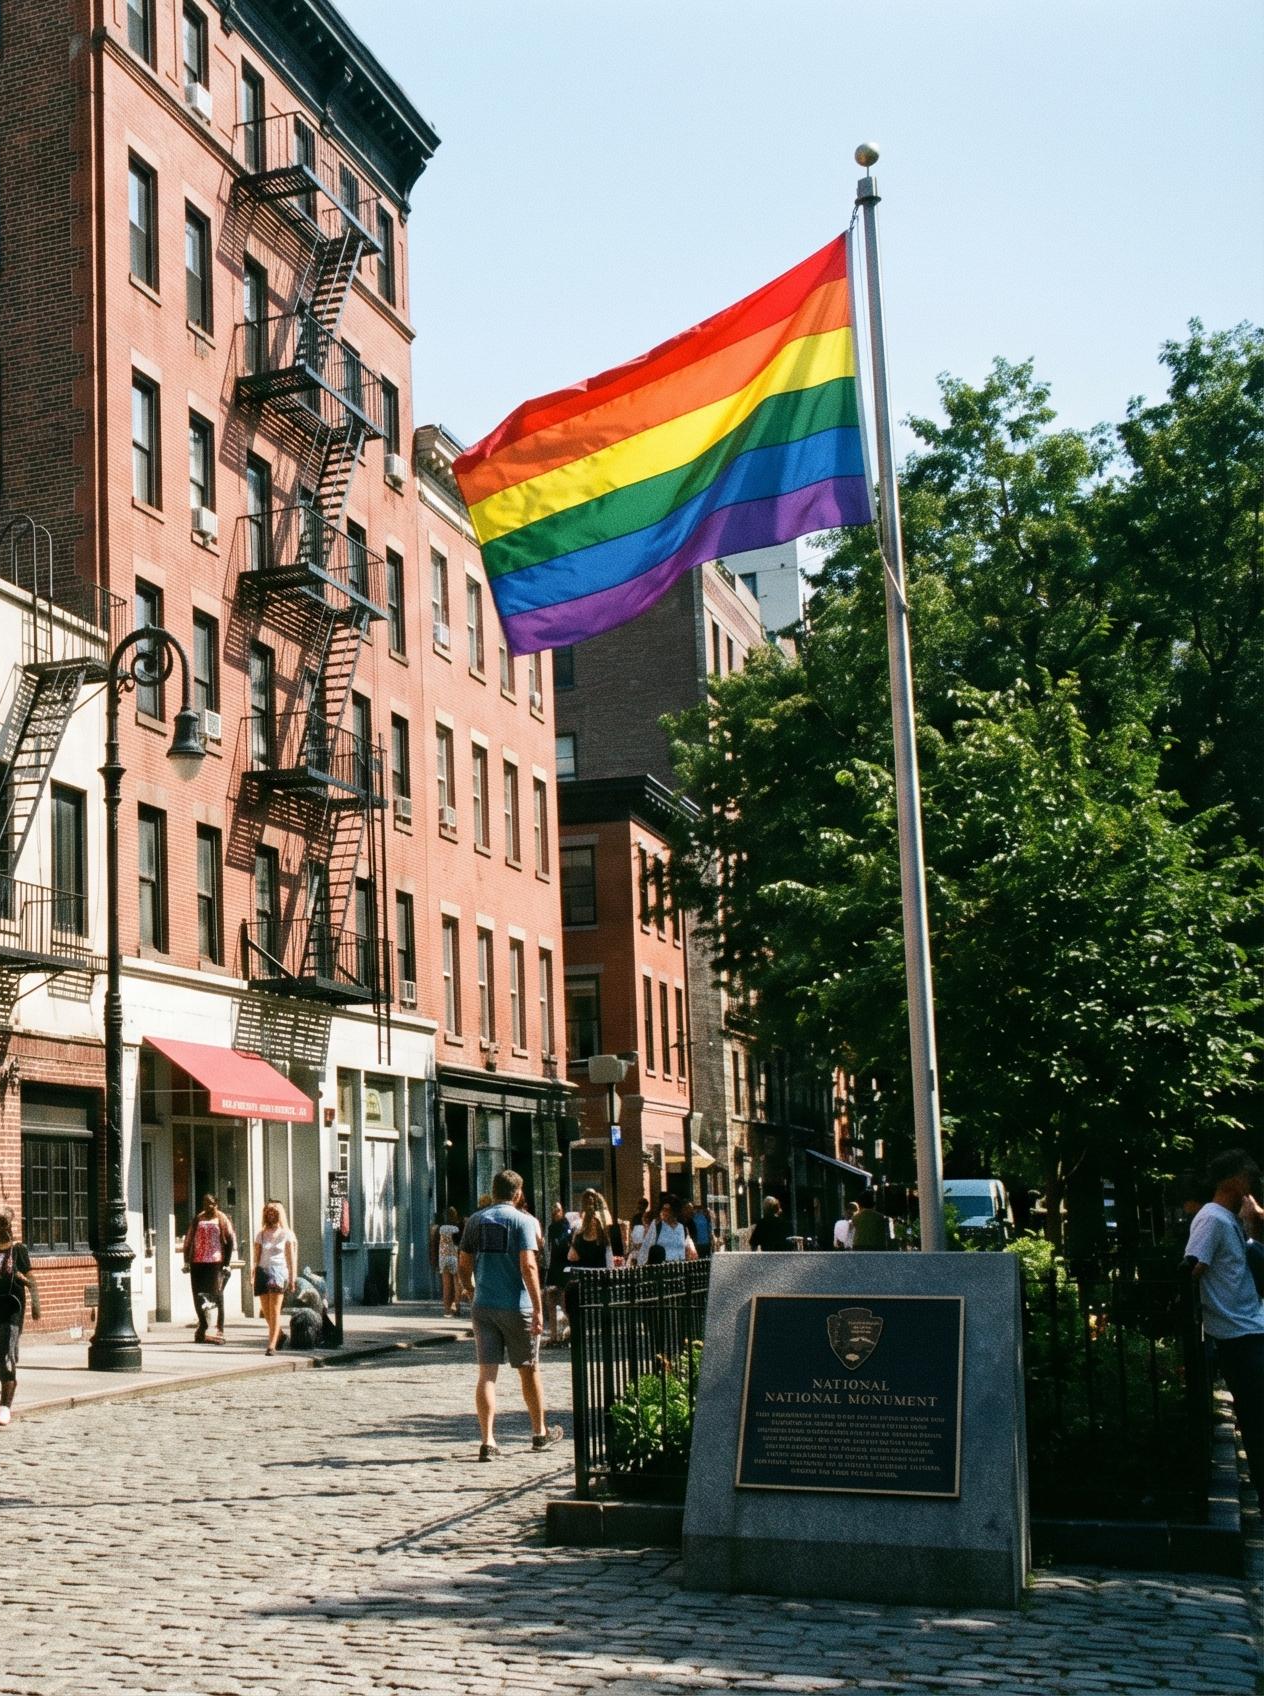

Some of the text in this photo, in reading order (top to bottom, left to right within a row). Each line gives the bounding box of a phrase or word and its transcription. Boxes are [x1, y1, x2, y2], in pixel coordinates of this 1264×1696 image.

[812, 1378, 890, 1392] NATIONAL
[764, 1391, 938, 1407] NATIONAL MONUMENT
